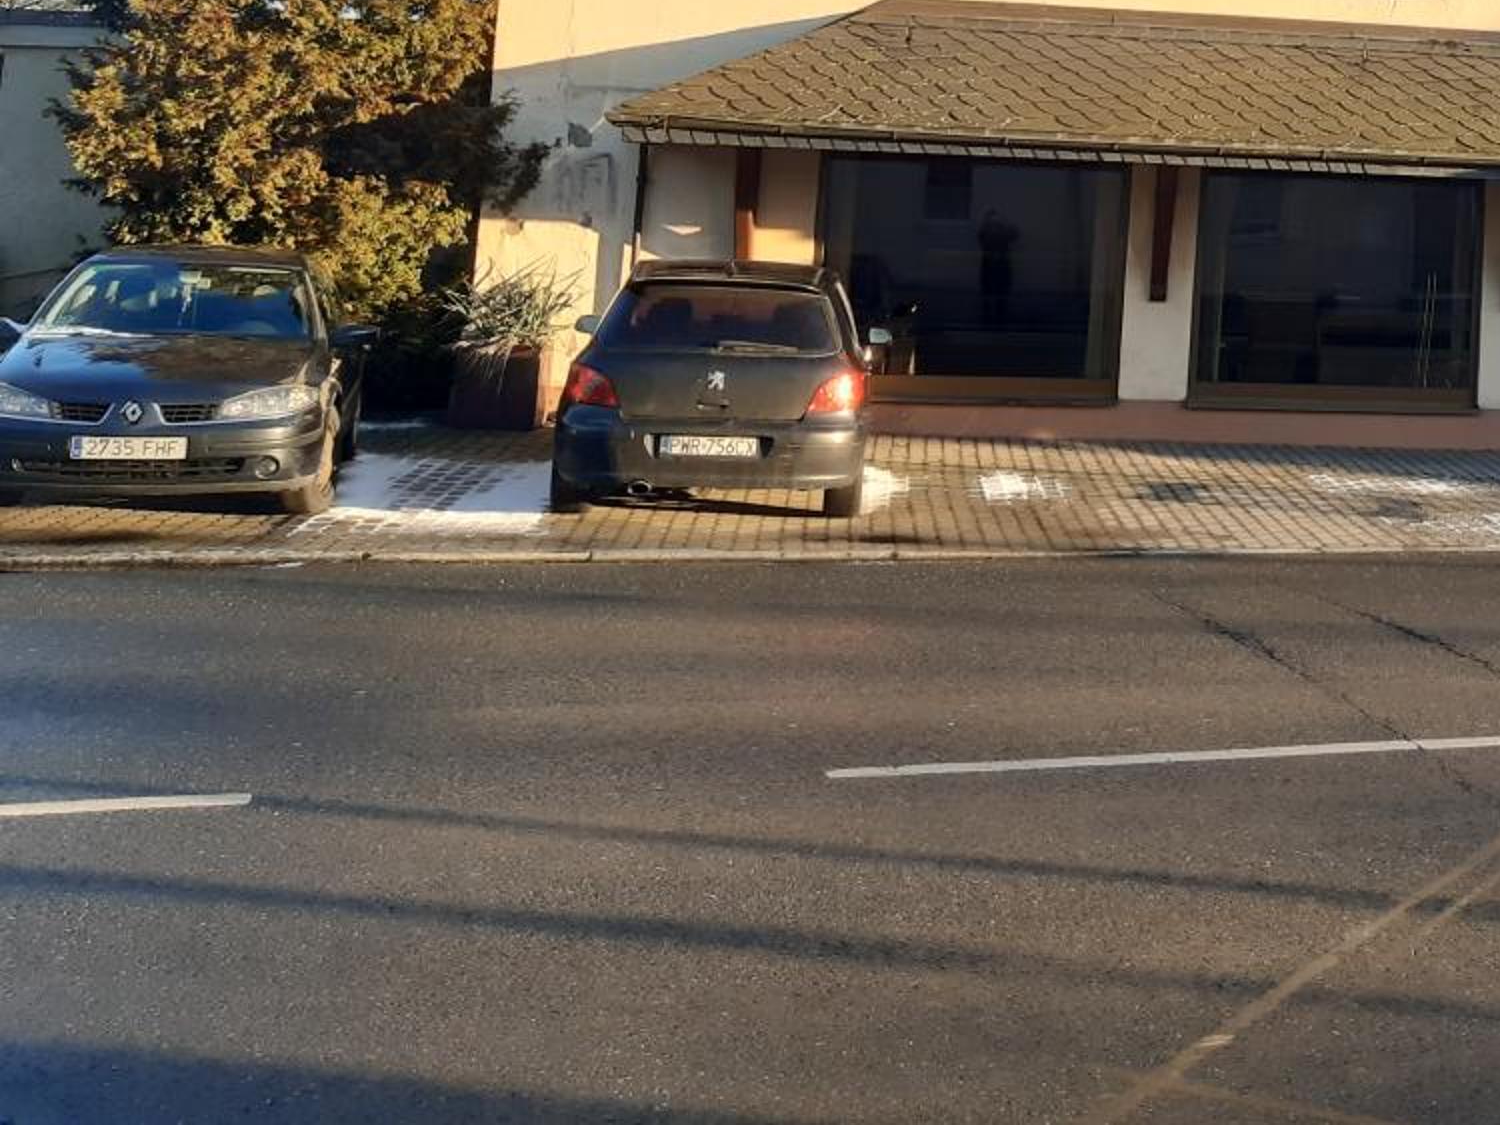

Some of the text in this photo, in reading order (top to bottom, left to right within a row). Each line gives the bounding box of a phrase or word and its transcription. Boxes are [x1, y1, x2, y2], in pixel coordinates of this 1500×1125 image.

[86, 440, 136, 456] 2735
[143, 440, 178, 456] FHF
[671, 438, 701, 454] PWR
